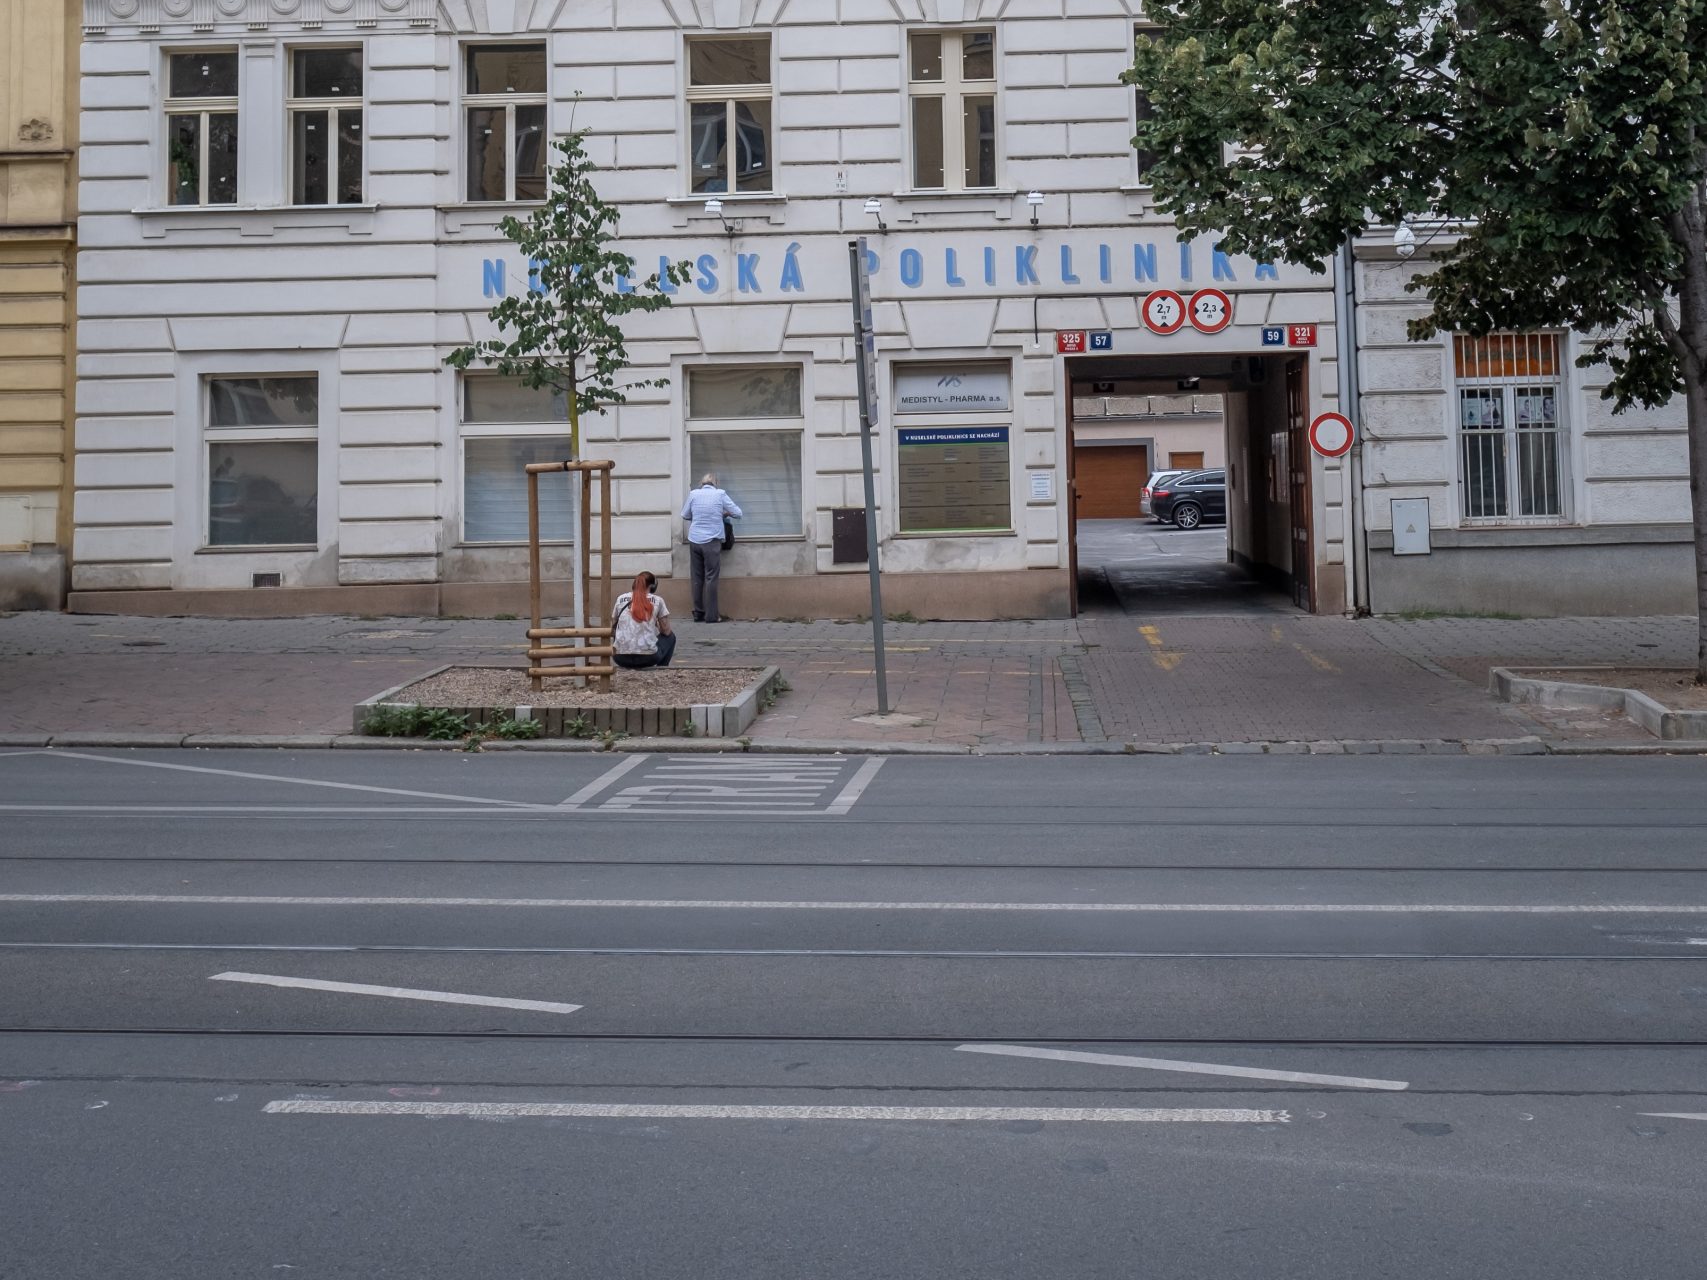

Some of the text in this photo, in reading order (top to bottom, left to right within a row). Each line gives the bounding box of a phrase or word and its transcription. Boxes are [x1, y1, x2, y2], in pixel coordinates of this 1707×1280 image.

[483, 242, 805, 299] NULSKÁ
[1157, 304, 1171, 315] 2,7
[1202, 302, 1217, 314] 2,3
[1267, 331, 1280, 341] 59
[1294, 326, 1311, 337] 321
[1062, 333, 1081, 344] 325
[1095, 336, 1107, 346] 57
[901, 396, 944, 404] MEDISTYL
[949, 395, 986, 403] PHARMA
[597, 757, 848, 809] TRAM
